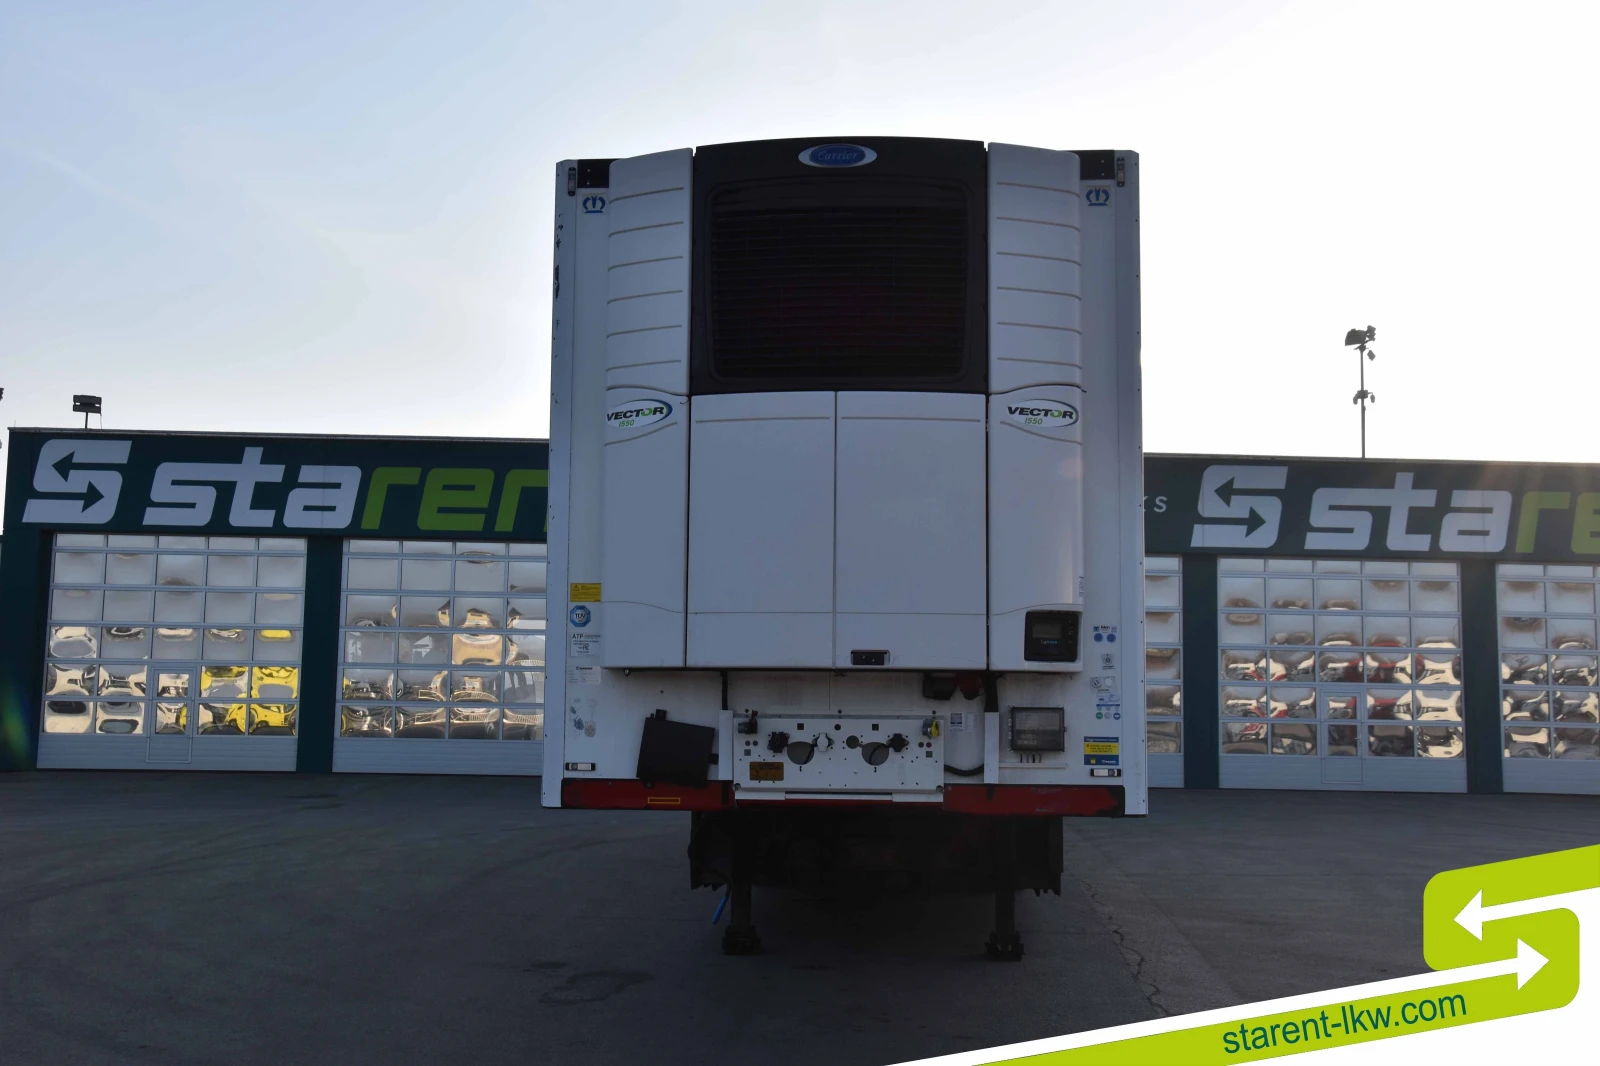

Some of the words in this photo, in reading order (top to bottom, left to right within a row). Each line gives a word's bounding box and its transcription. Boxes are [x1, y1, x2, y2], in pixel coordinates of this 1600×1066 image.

[818, 150, 859, 161] Carrier
[607, 406, 664, 421] VECTOR
[1008, 406, 1074, 419] VECTOR
[618, 420, 634, 428] 1550
[1025, 417, 1043, 425] 1550
